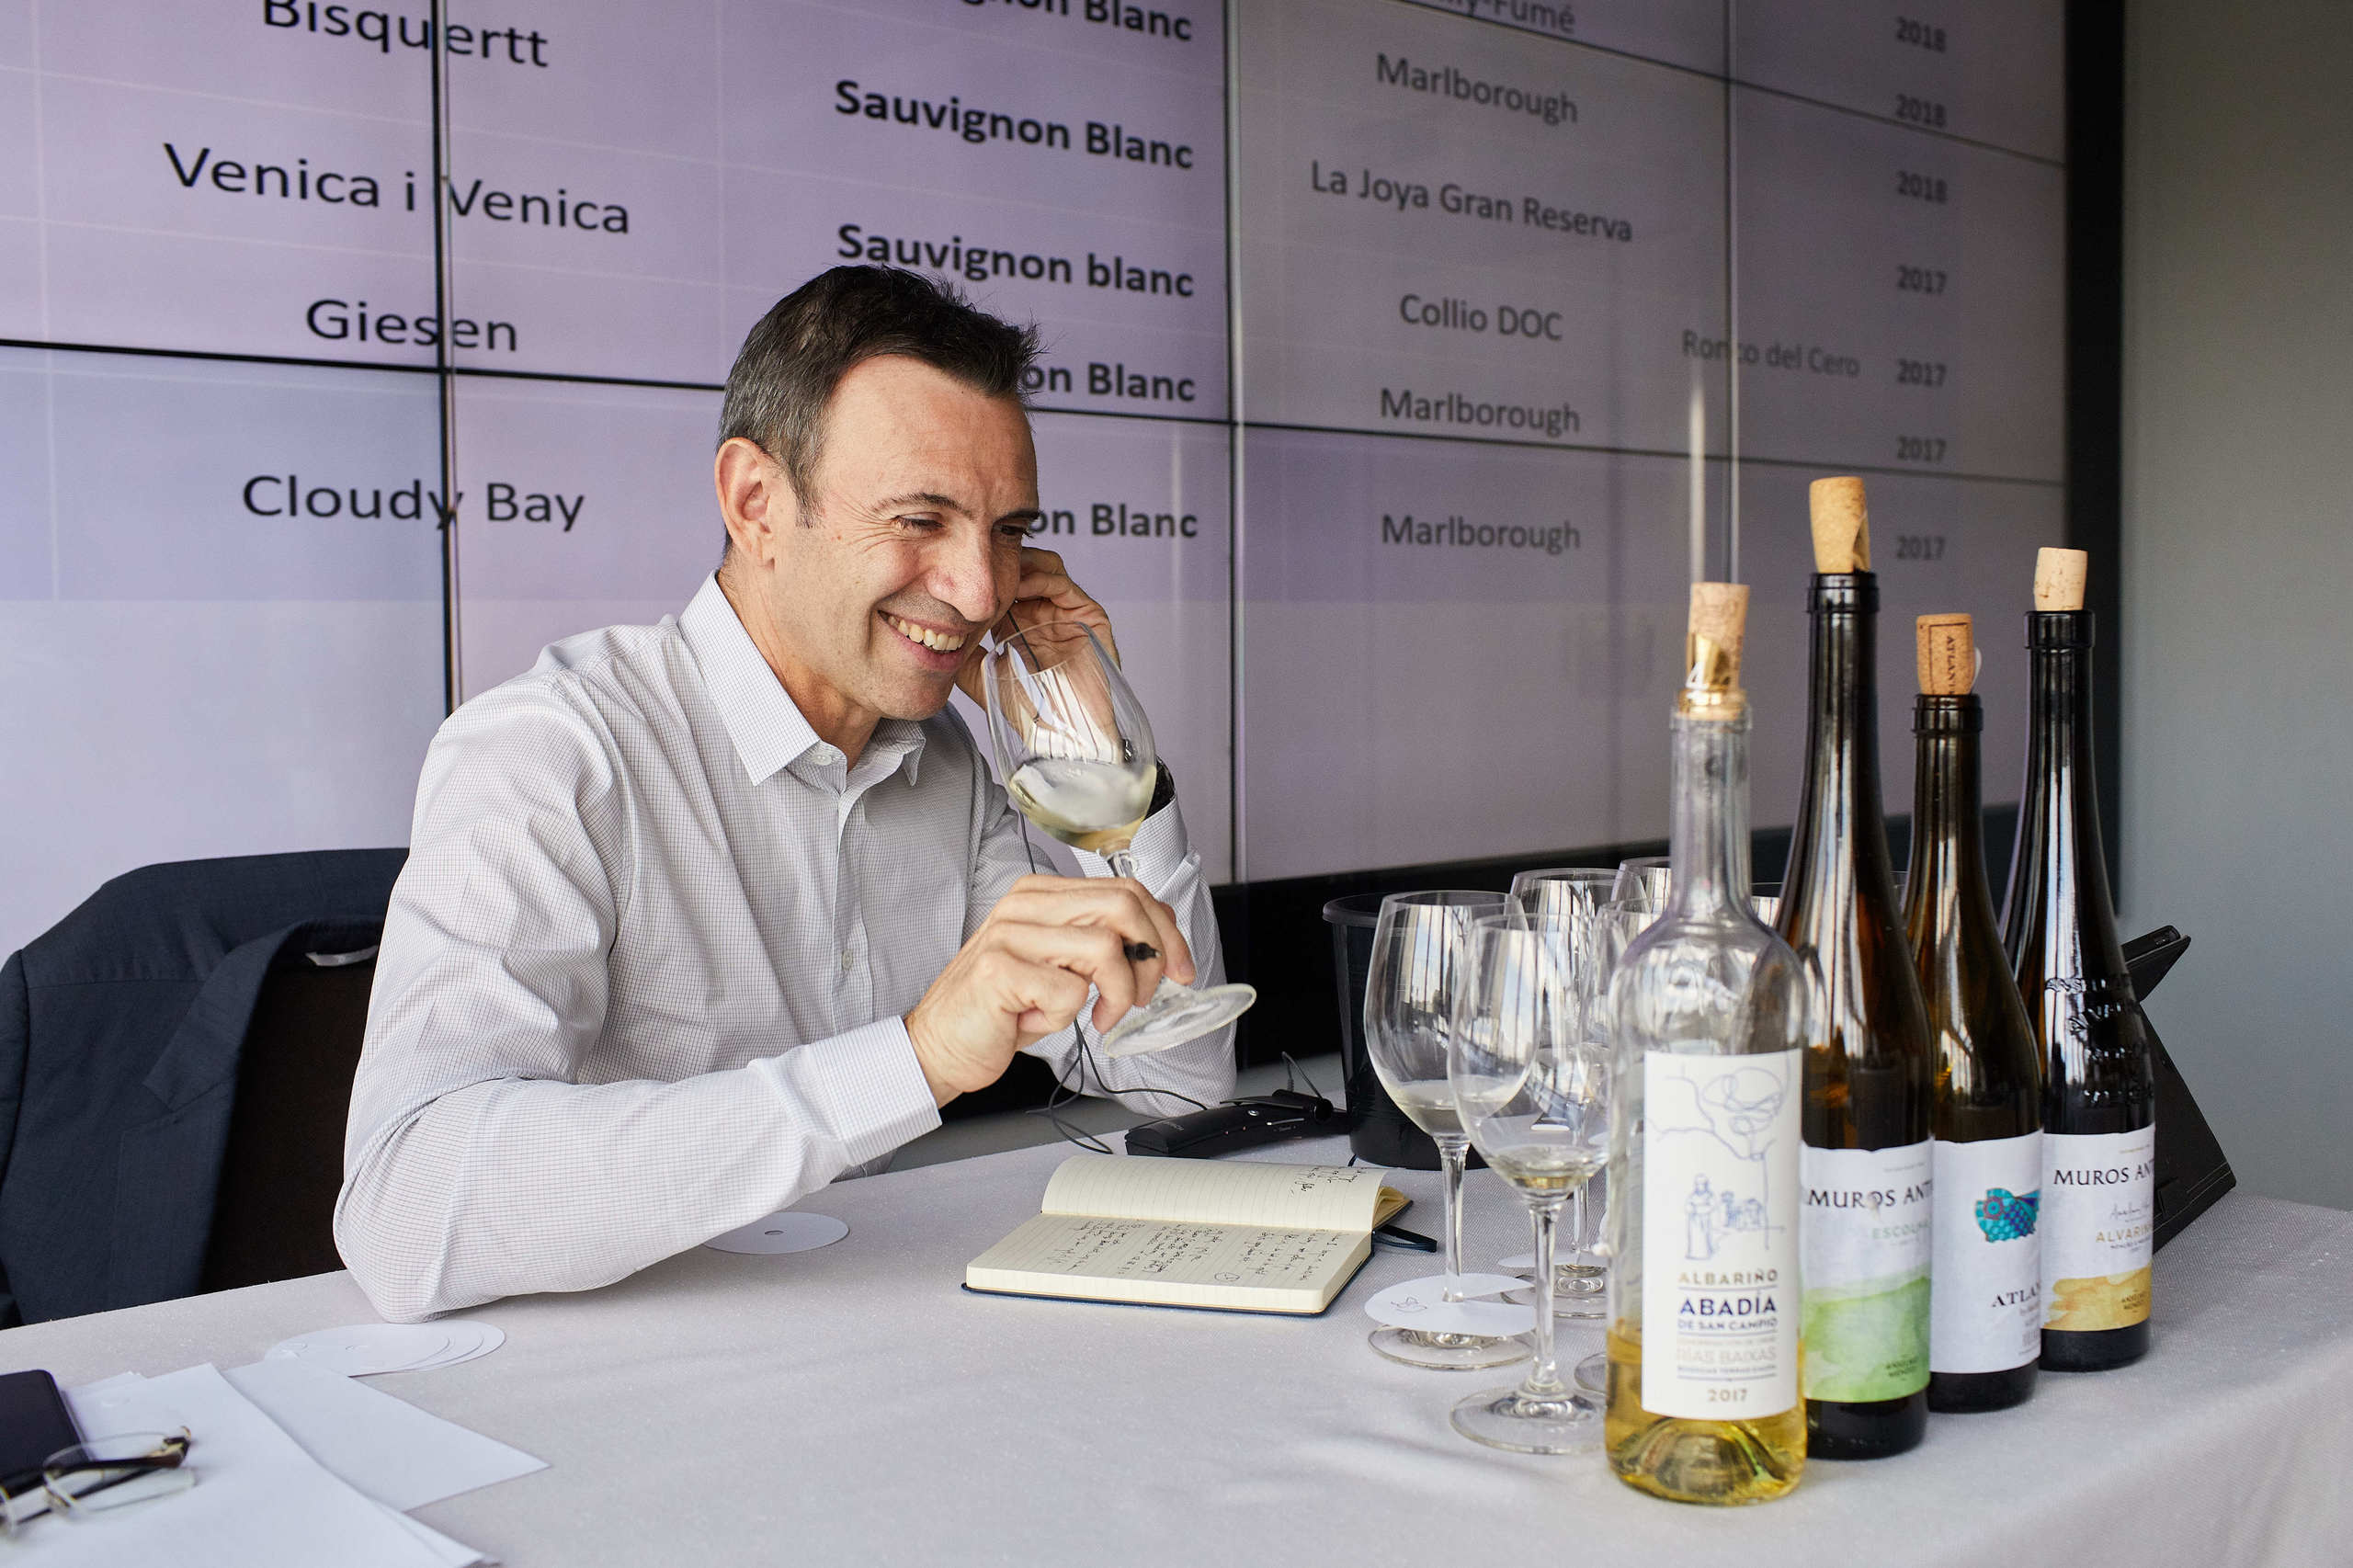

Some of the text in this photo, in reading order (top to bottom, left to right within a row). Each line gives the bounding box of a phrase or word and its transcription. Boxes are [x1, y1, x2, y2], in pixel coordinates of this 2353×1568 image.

[263, 0, 549, 67] Bisquertt
[1085, 0, 1192, 41] Blanc
[1378, 52, 1578, 126] Marlborough
[835, 79, 1193, 170] Sauvignon Blanc
[164, 142, 631, 234] Venica i Venica
[1311, 160, 1632, 243] La Joya Gran Reserva
[837, 224, 1194, 298] Sauvignon blanc
[1896, 266, 1947, 296] 2017
[305, 300, 517, 352] Giesen
[1399, 294, 1563, 341] Collio DOC
[1766, 343, 1802, 369] del
[1896, 359, 1948, 386] 2017
[1088, 361, 1195, 403] Blanc
[1380, 388, 1580, 438] Marlborough
[1896, 436, 1947, 461] 2017
[243, 474, 585, 532] Cloudy Bay
[1091, 503, 1198, 539] Blanc
[1381, 515, 1581, 555] Marlborough
[1895, 537, 1947, 561] 2017
[2053, 1167, 2130, 1186] MUROS
[1808, 1188, 1896, 1208] MUROS
[1677, 1267, 1779, 1285] ALBARIÑO
[1679, 1289, 1777, 1316] ABADÍA
[1707, 1389, 1748, 1403] 2017
